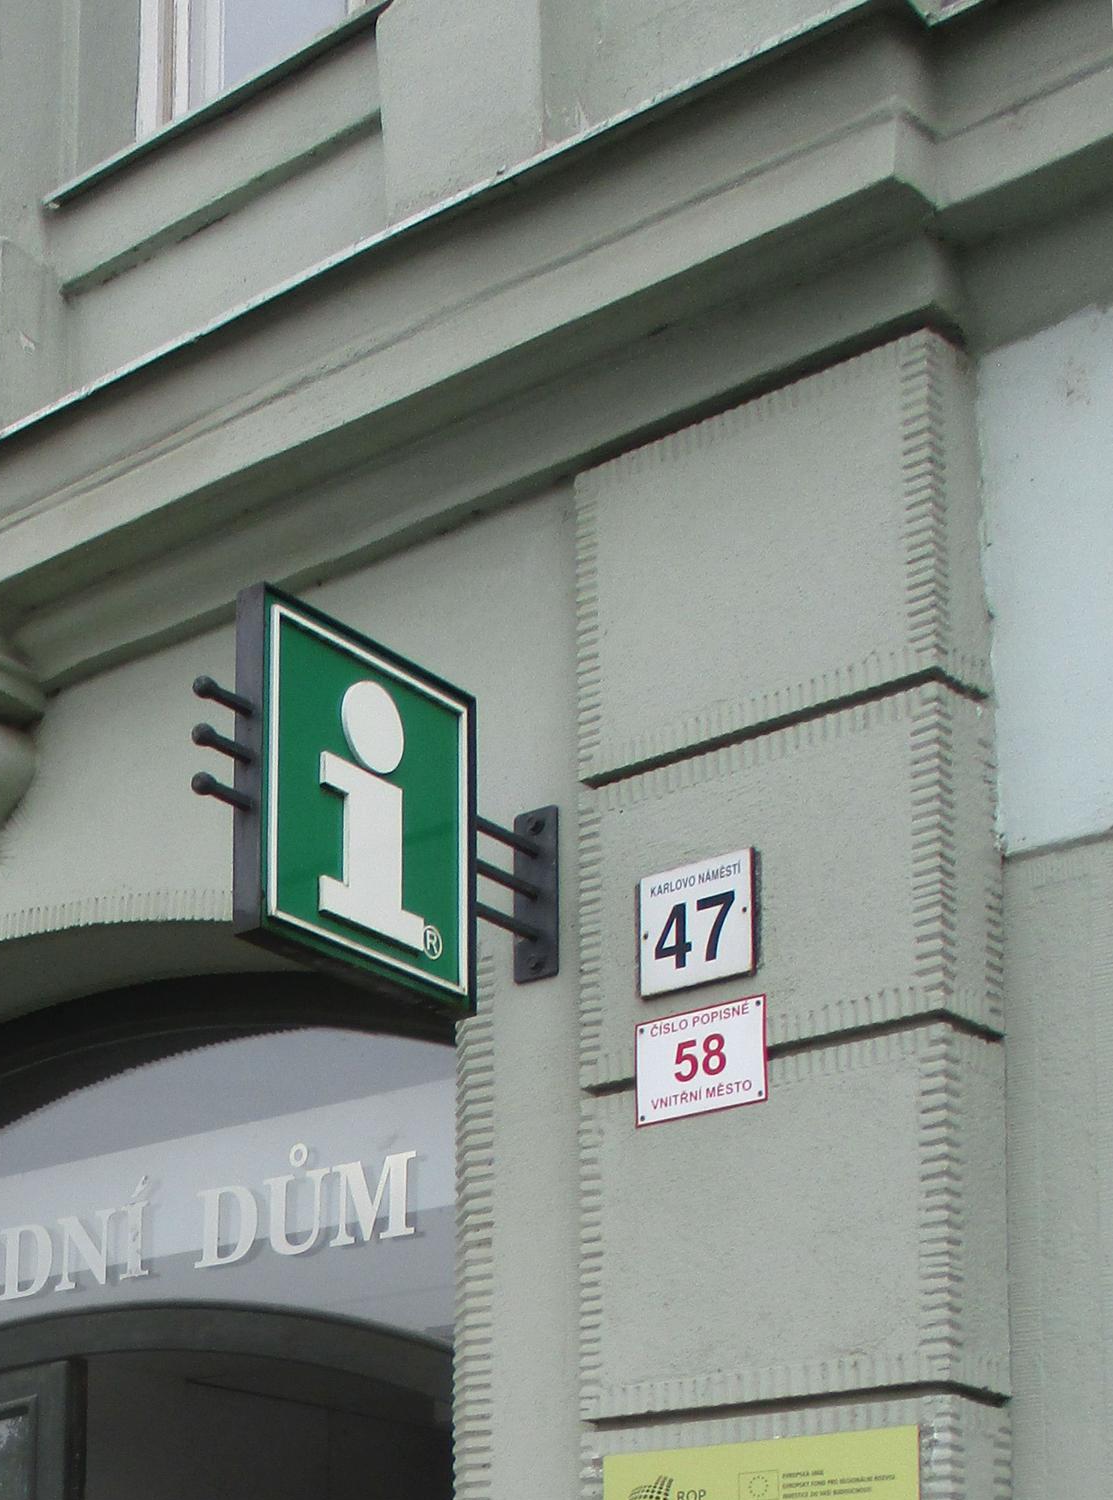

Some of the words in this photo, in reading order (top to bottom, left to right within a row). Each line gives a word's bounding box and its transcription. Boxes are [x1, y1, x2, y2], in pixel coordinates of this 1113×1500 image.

[649, 873, 696, 898] KARLOVO
[698, 859, 742, 884] NÁMĚSTÍ
[654, 889, 736, 970] 47
[649, 1017, 689, 1039] ČÍSLO
[691, 1000, 750, 1029] POPISNÉ
[673, 1032, 727, 1083] 58
[651, 1086, 703, 1111] VNITŘNÍ
[705, 1078, 753, 1100] MĚSTO
[194, 1142, 417, 1268] DŮM
